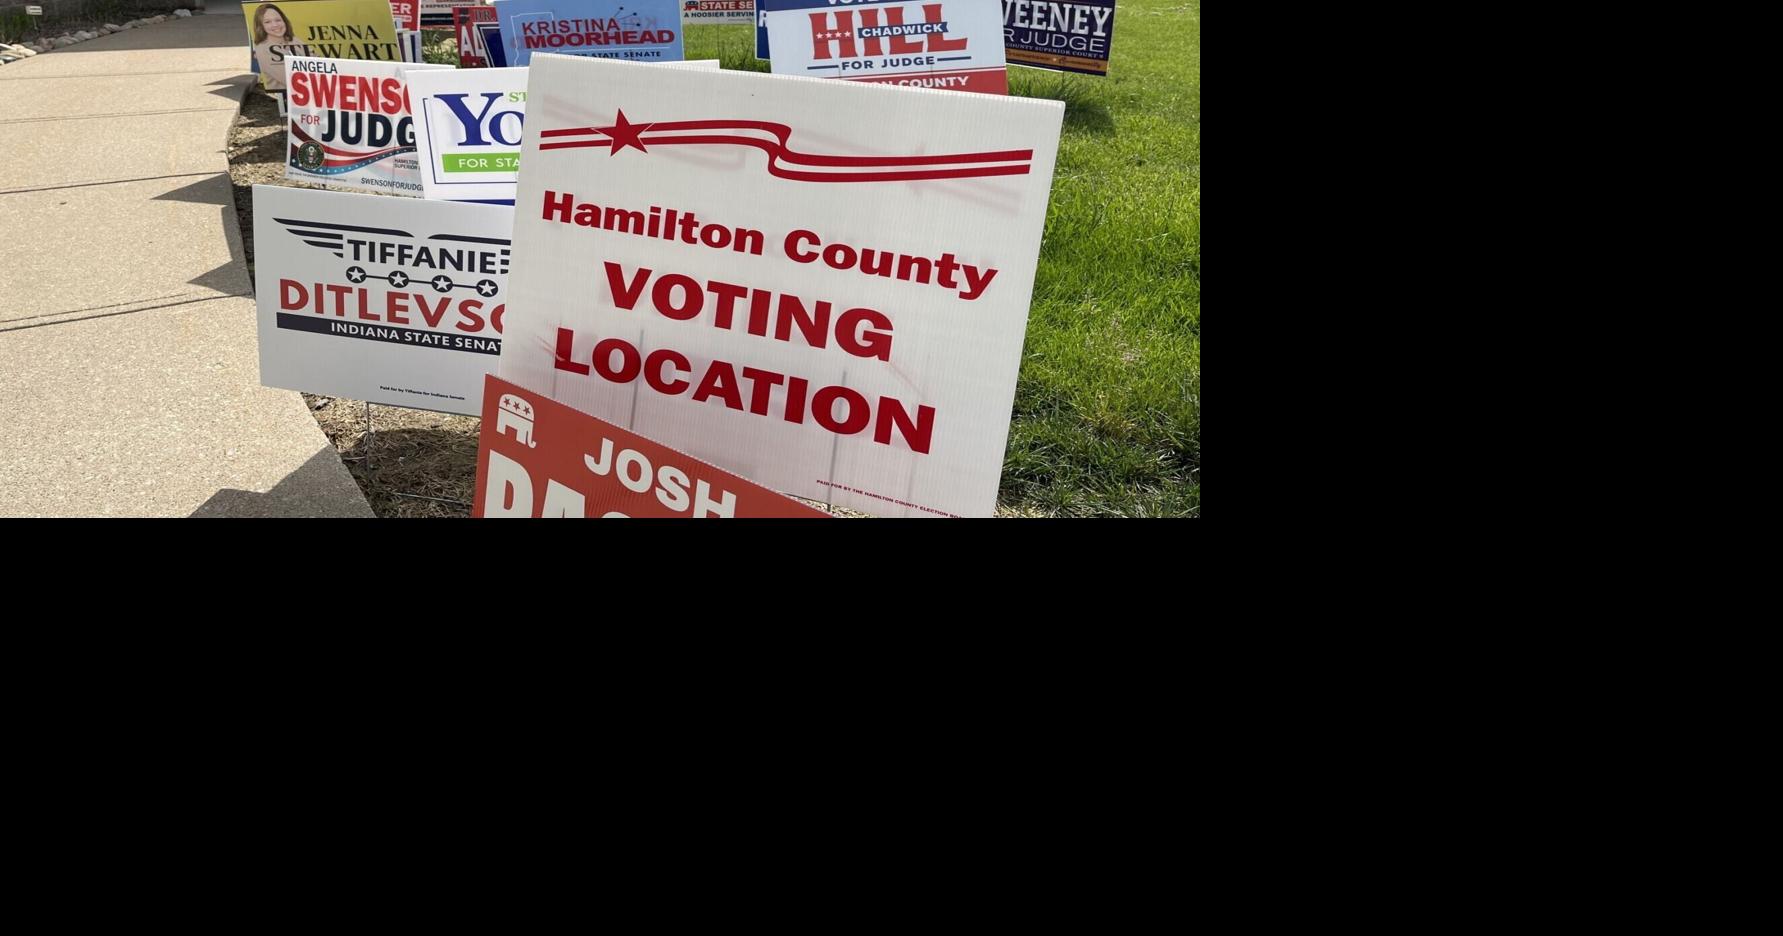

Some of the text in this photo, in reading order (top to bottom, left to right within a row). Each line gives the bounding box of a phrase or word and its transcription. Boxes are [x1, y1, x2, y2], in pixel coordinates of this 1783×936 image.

[702, 0, 754, 9] STATE SE
[308, 25, 379, 41] JENNA
[522, 17, 621, 36] KRISTINA
[808, 4, 968, 59] HILL
[861, 23, 943, 37] CHADWICK
[524, 30, 675, 49] MOORHEAD
[1020, 31, 1106, 53] JUDGE
[269, 43, 398, 62] STEWART
[292, 60, 338, 74] ANGELA
[841, 56, 935, 70] FOR JUDGE
[898, 76, 969, 88] COUNTY
[301, 110, 416, 148] FOR JUDG
[458, 158, 488, 169] FOR
[541, 190, 998, 301] Hamilton County
[347, 239, 496, 275] TIFFANIE
[603, 262, 894, 362] VOTING
[331, 322, 399, 340] INDIANA
[405, 332, 450, 346] STATE
[554, 327, 936, 455] LOCATION
[584, 437, 737, 519] JOSH
[865, 492, 893, 502] HAMILTON
[895, 499, 918, 509] COUNTY
[920, 506, 948, 516] ELECTION
